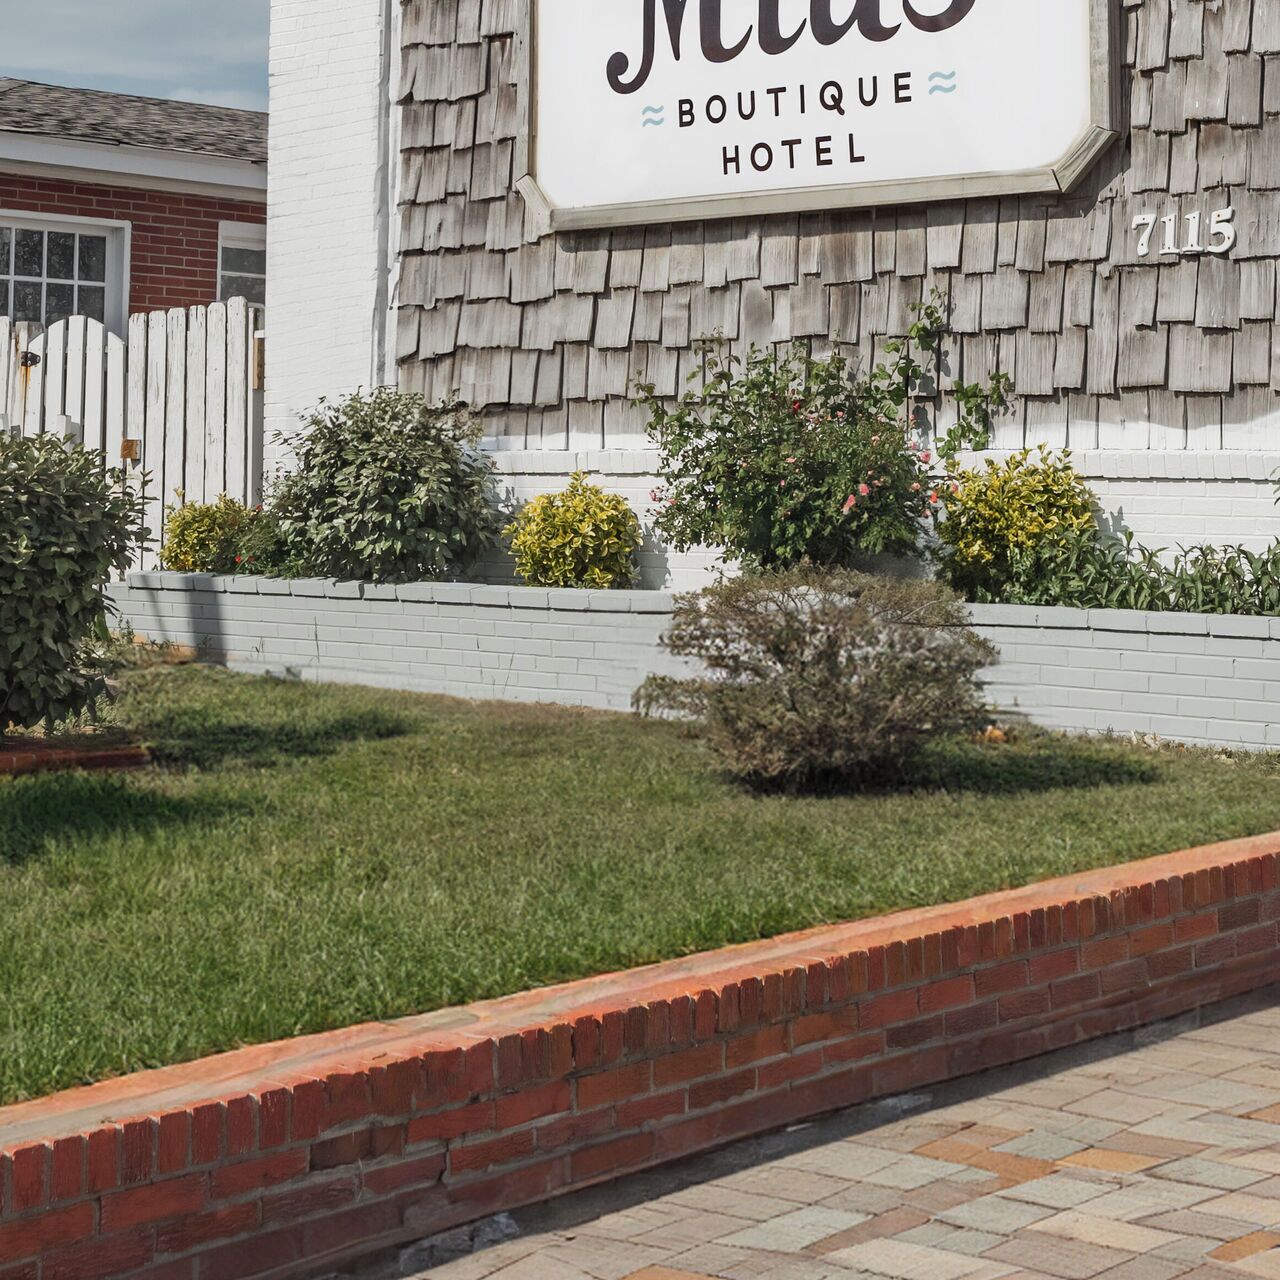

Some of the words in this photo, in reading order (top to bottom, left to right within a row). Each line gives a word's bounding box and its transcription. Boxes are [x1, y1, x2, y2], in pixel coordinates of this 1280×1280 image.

[677, 71, 913, 128] BOUTIQUE
[721, 133, 866, 175] HOTEL
[1131, 206, 1238, 257] 7115
